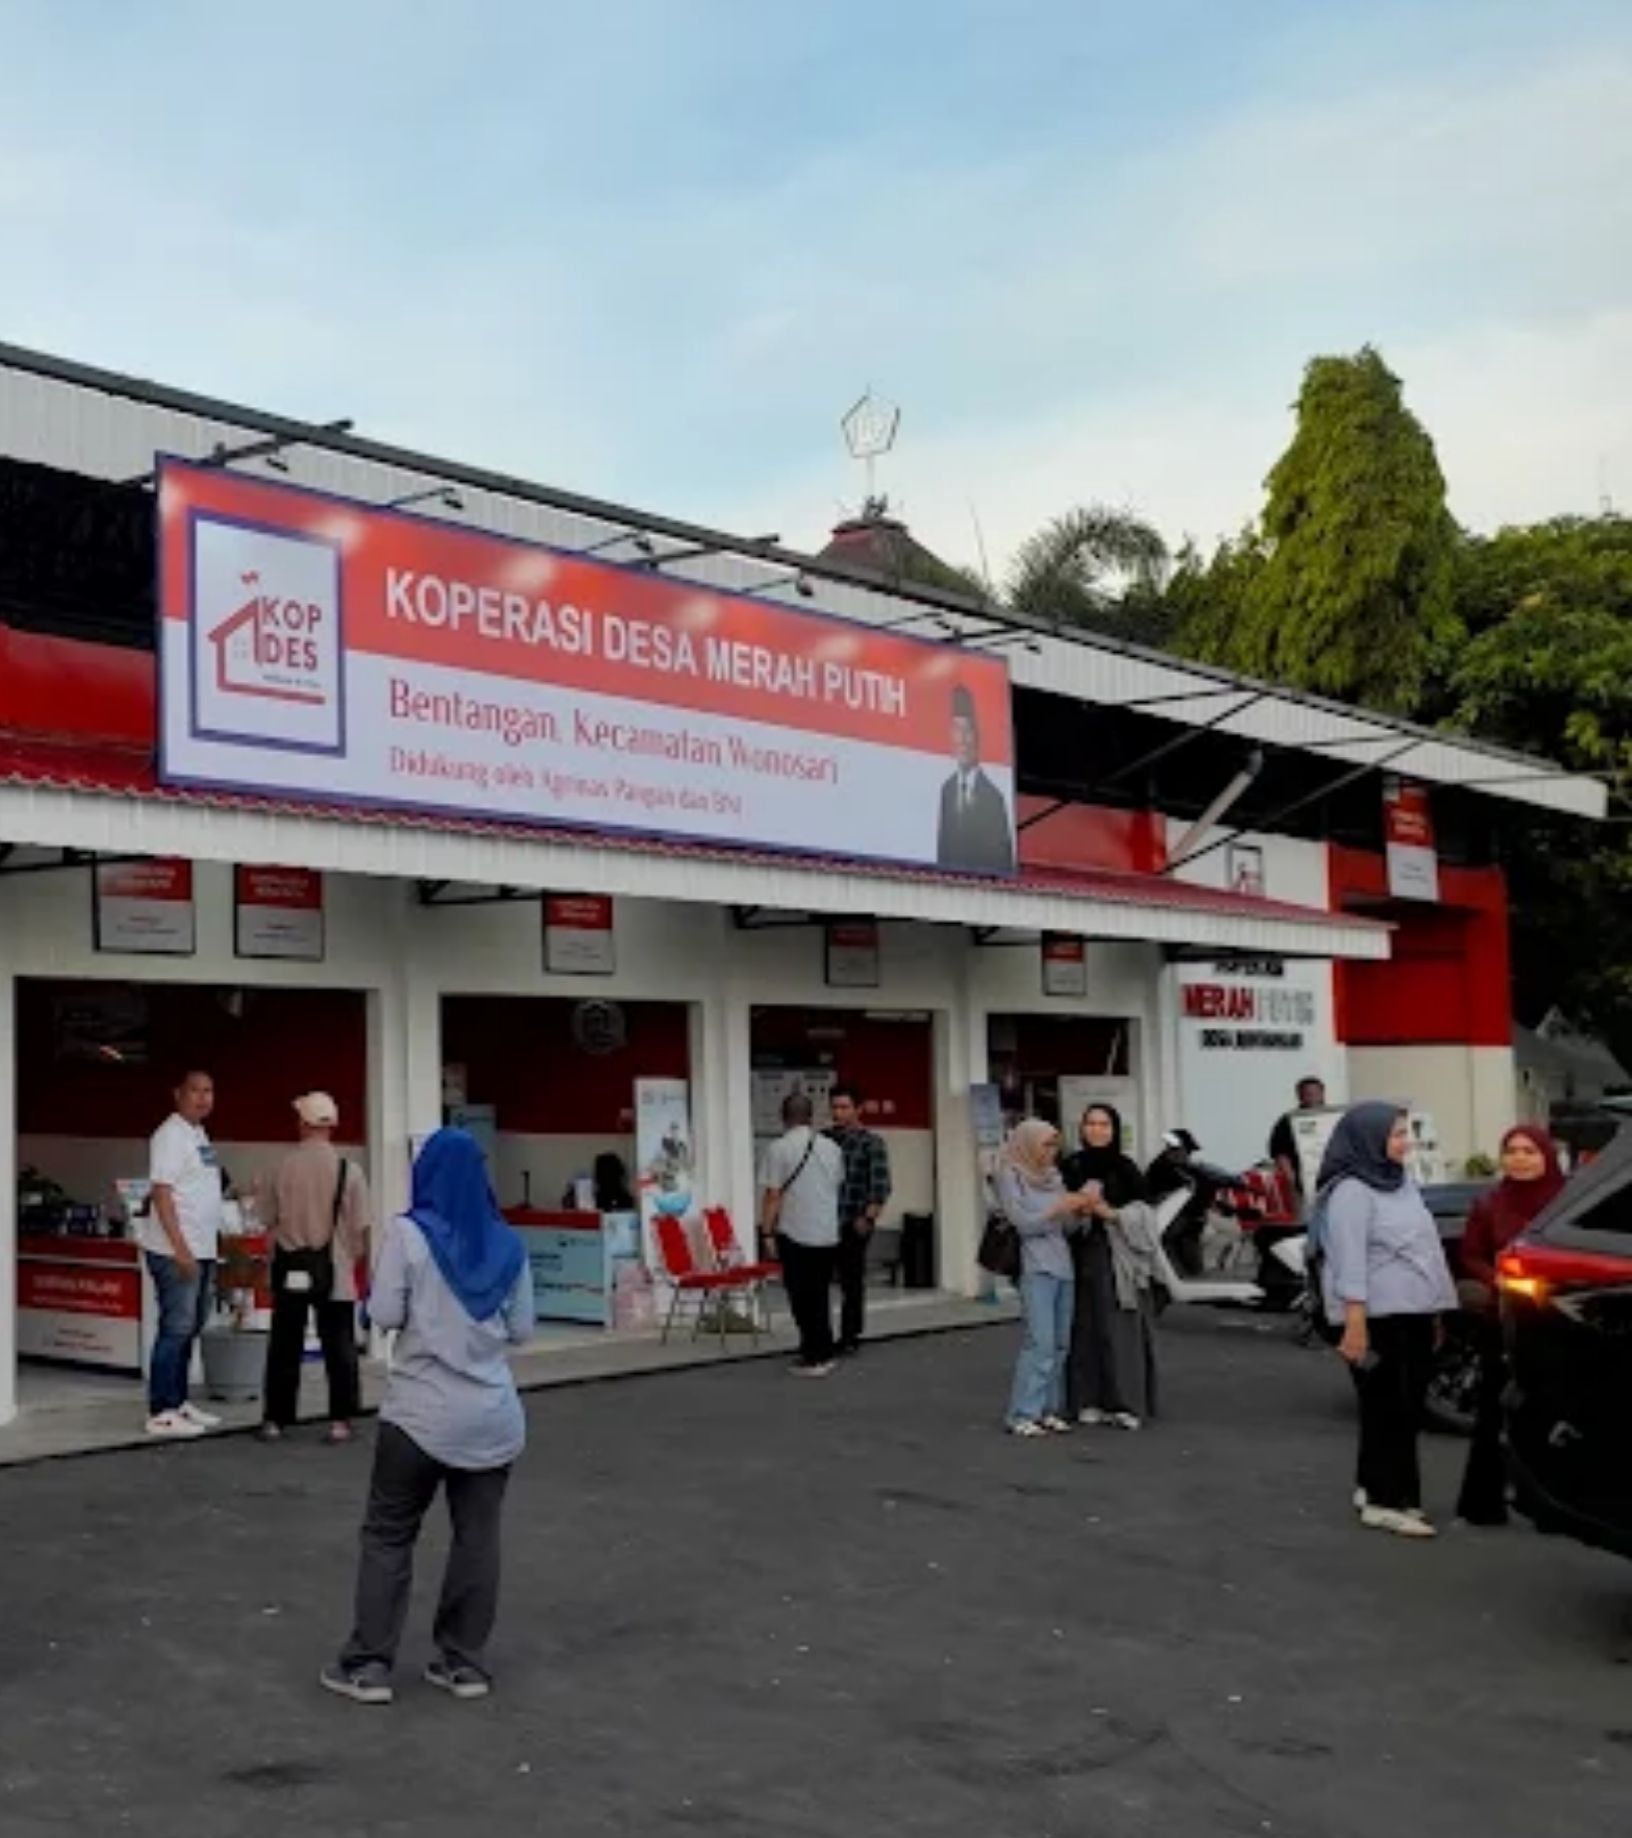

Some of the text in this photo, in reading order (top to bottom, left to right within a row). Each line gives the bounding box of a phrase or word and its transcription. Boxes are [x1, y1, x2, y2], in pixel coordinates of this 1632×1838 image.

[261, 595, 322, 634] KOP
[262, 633, 318, 671] DES
[386, 566, 907, 718] KOPERASI DESA MERAH PUTIH
[573, 707, 721, 766] Kecamatan
[1181, 984, 1254, 1020] MERAH
